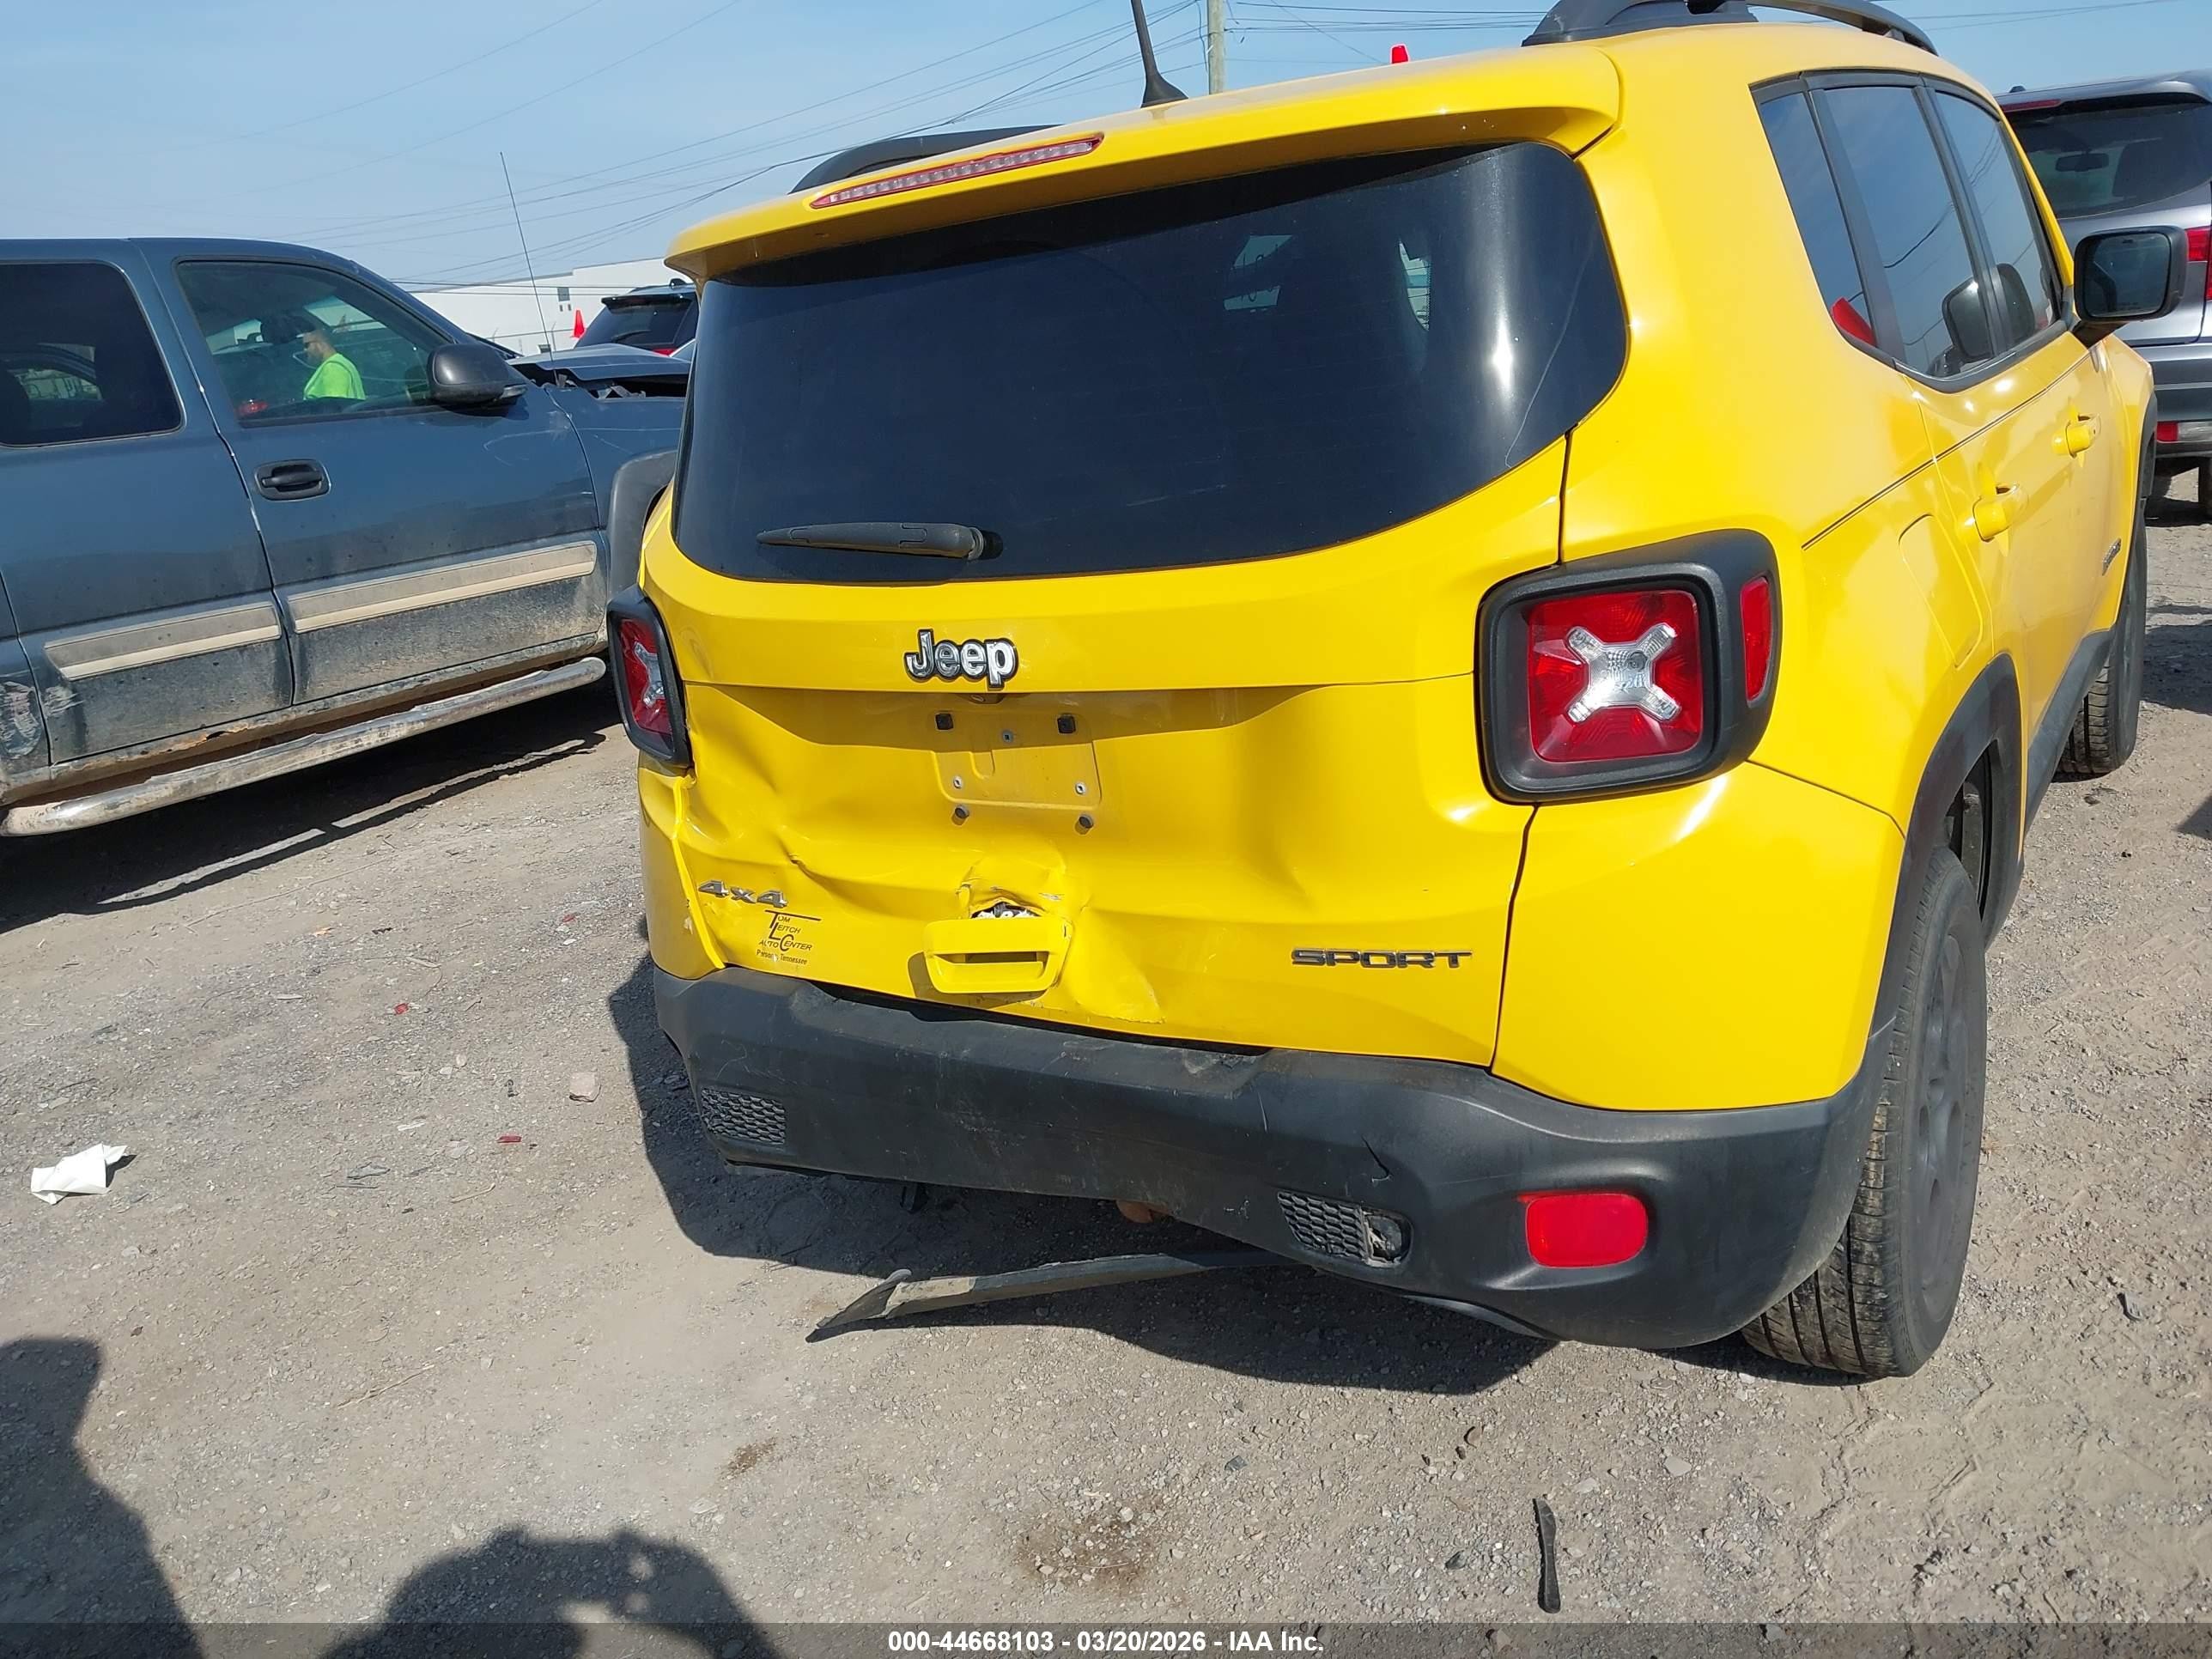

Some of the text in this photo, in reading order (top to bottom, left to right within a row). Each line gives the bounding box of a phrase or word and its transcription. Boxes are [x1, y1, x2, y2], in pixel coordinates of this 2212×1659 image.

[904, 629, 1018, 688] Jeep
[698, 880, 787, 908] 4x4
[780, 933, 812, 951] CENTER
[780, 953, 807, 964] Tennessee
[1291, 948, 1474, 968] SPORT
